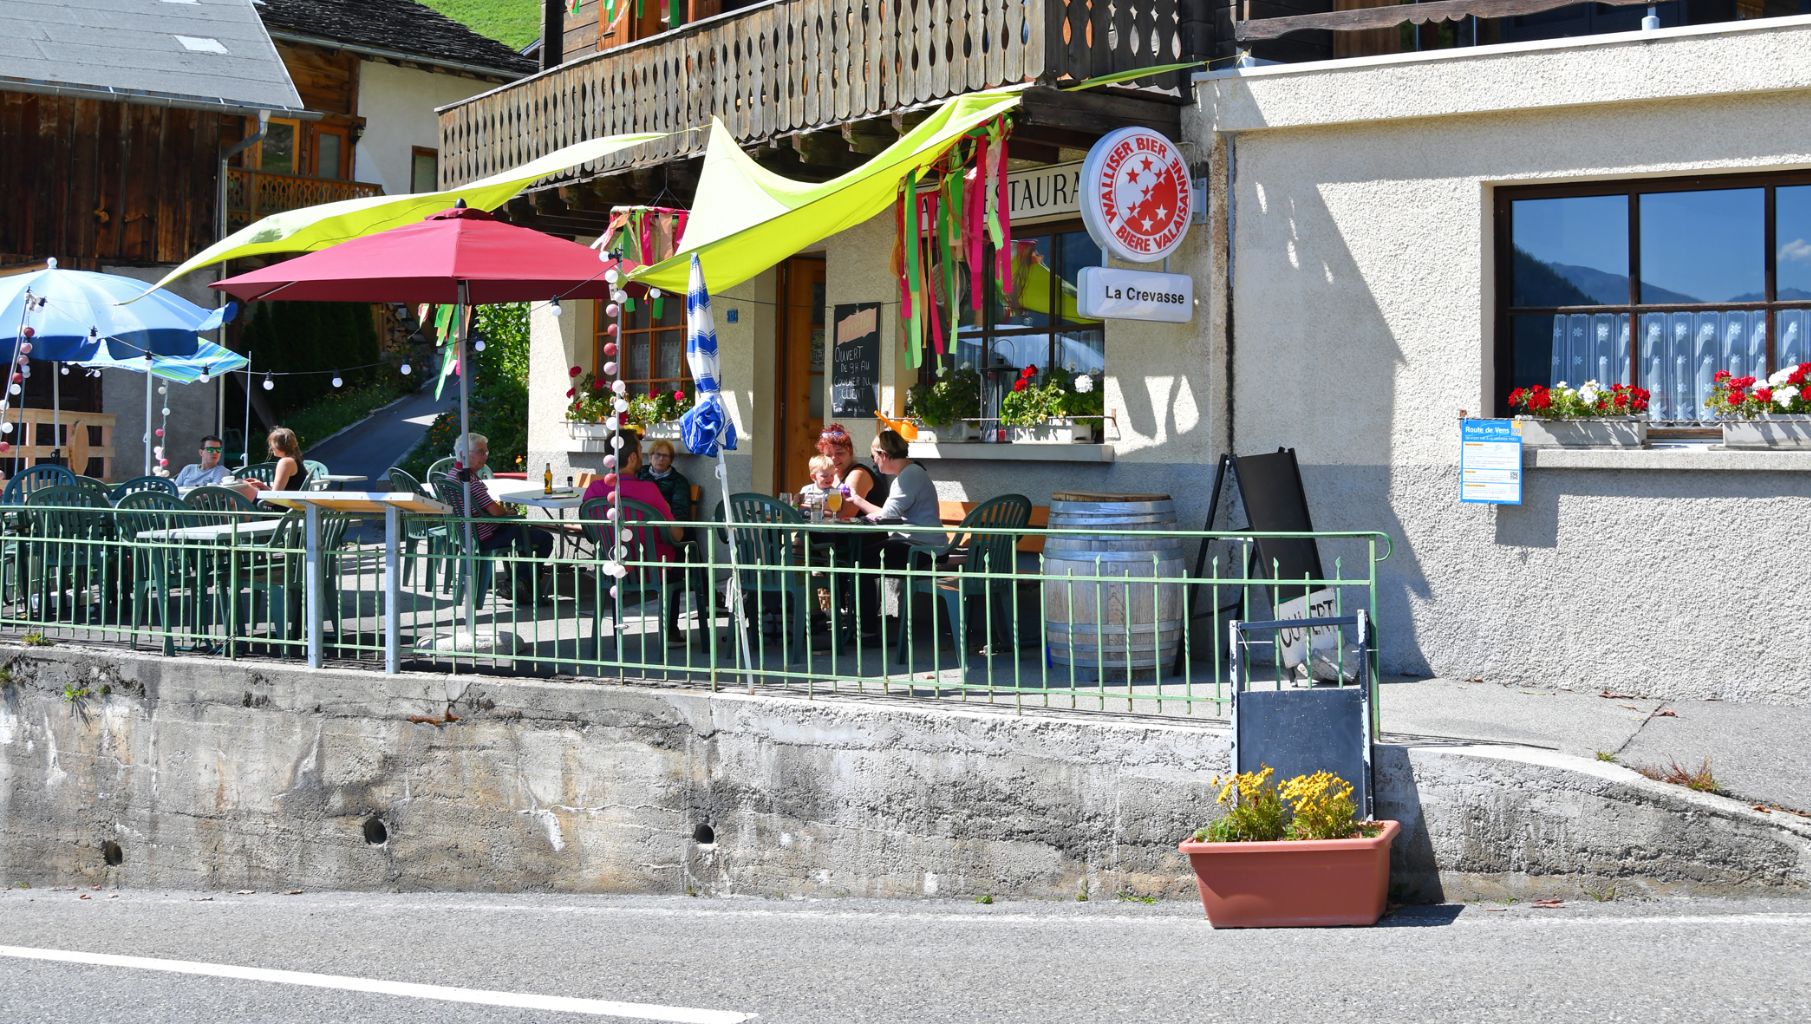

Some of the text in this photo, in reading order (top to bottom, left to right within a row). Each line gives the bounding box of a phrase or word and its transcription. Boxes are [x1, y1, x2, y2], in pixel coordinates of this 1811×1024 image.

[1101, 137, 1167, 224] WALLISER BIER
[1115, 157, 1189, 252] BIERE VALAISANNE
[1105, 285, 1185, 304] La Crevasse
[834, 345, 864, 363] OUVERT
[1465, 426, 1484, 434] Route
[1279, 599, 1335, 648] OUERT
